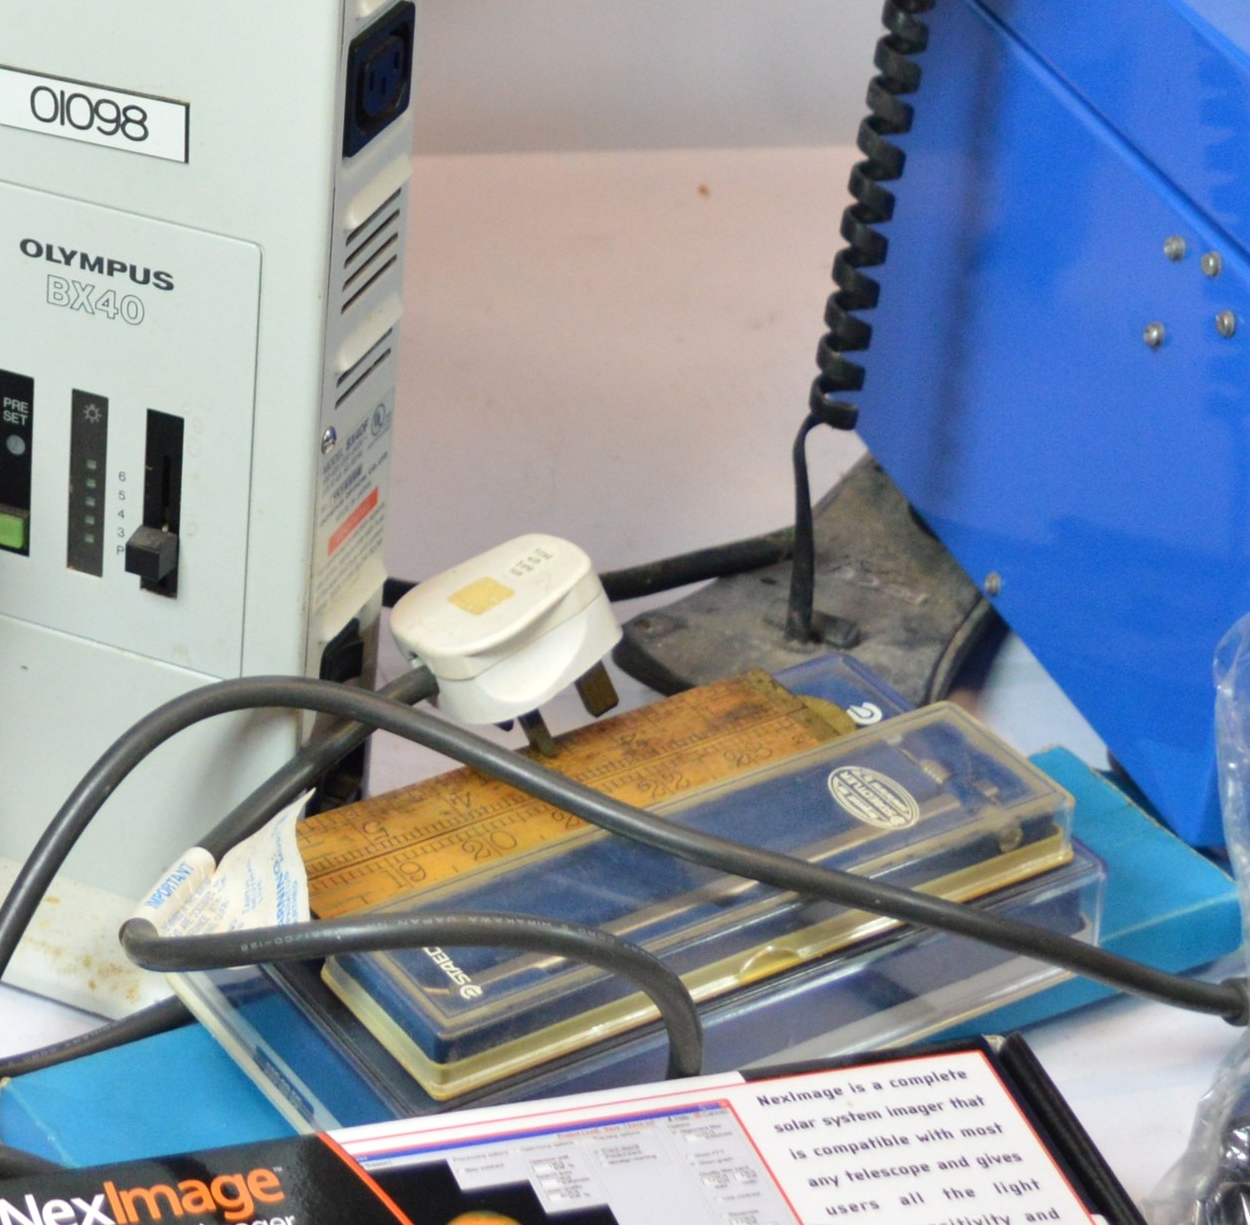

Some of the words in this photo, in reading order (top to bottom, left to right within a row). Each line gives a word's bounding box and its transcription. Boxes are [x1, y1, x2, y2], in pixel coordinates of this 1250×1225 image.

[30, 85, 149, 142] 01098
[19, 238, 175, 292] OLYMPUS
[46, 274, 145, 326] BX40
[3, 397, 29, 414] PRE
[3, 410, 29, 425] SET
[117, 509, 126, 519] 4
[118, 490, 126, 501] 5
[117, 527, 126, 538] 3
[145, 861, 195, 911] IMPORTANT
[756, 1084, 843, 1108] NexImage
[849, 1082, 866, 1095] is
[872, 1081, 883, 1092] a
[889, 1068, 968, 1093] complete
[774, 1118, 816, 1134] solar
[822, 1104, 883, 1128] system
[886, 1098, 946, 1118] imager
[949, 1093, 986, 1110] that
[789, 1148, 807, 1161] is
[813, 1134, 910, 1159] compatible
[916, 1128, 955, 1145] with
[960, 1122, 1004, 1139] most
[808, 1175, 839, 1190] any
[845, 1160, 931, 1184] telescope
[936, 1155, 970, 1171] and
[976, 1151, 1024, 1170] gives
[825, 1199, 881, 1218] users
[899, 1191, 926, 1207] all
[942, 1186, 977, 1202] the
[993, 1178, 1042, 1198] light
[1024, 1206, 1062, 1225] and
